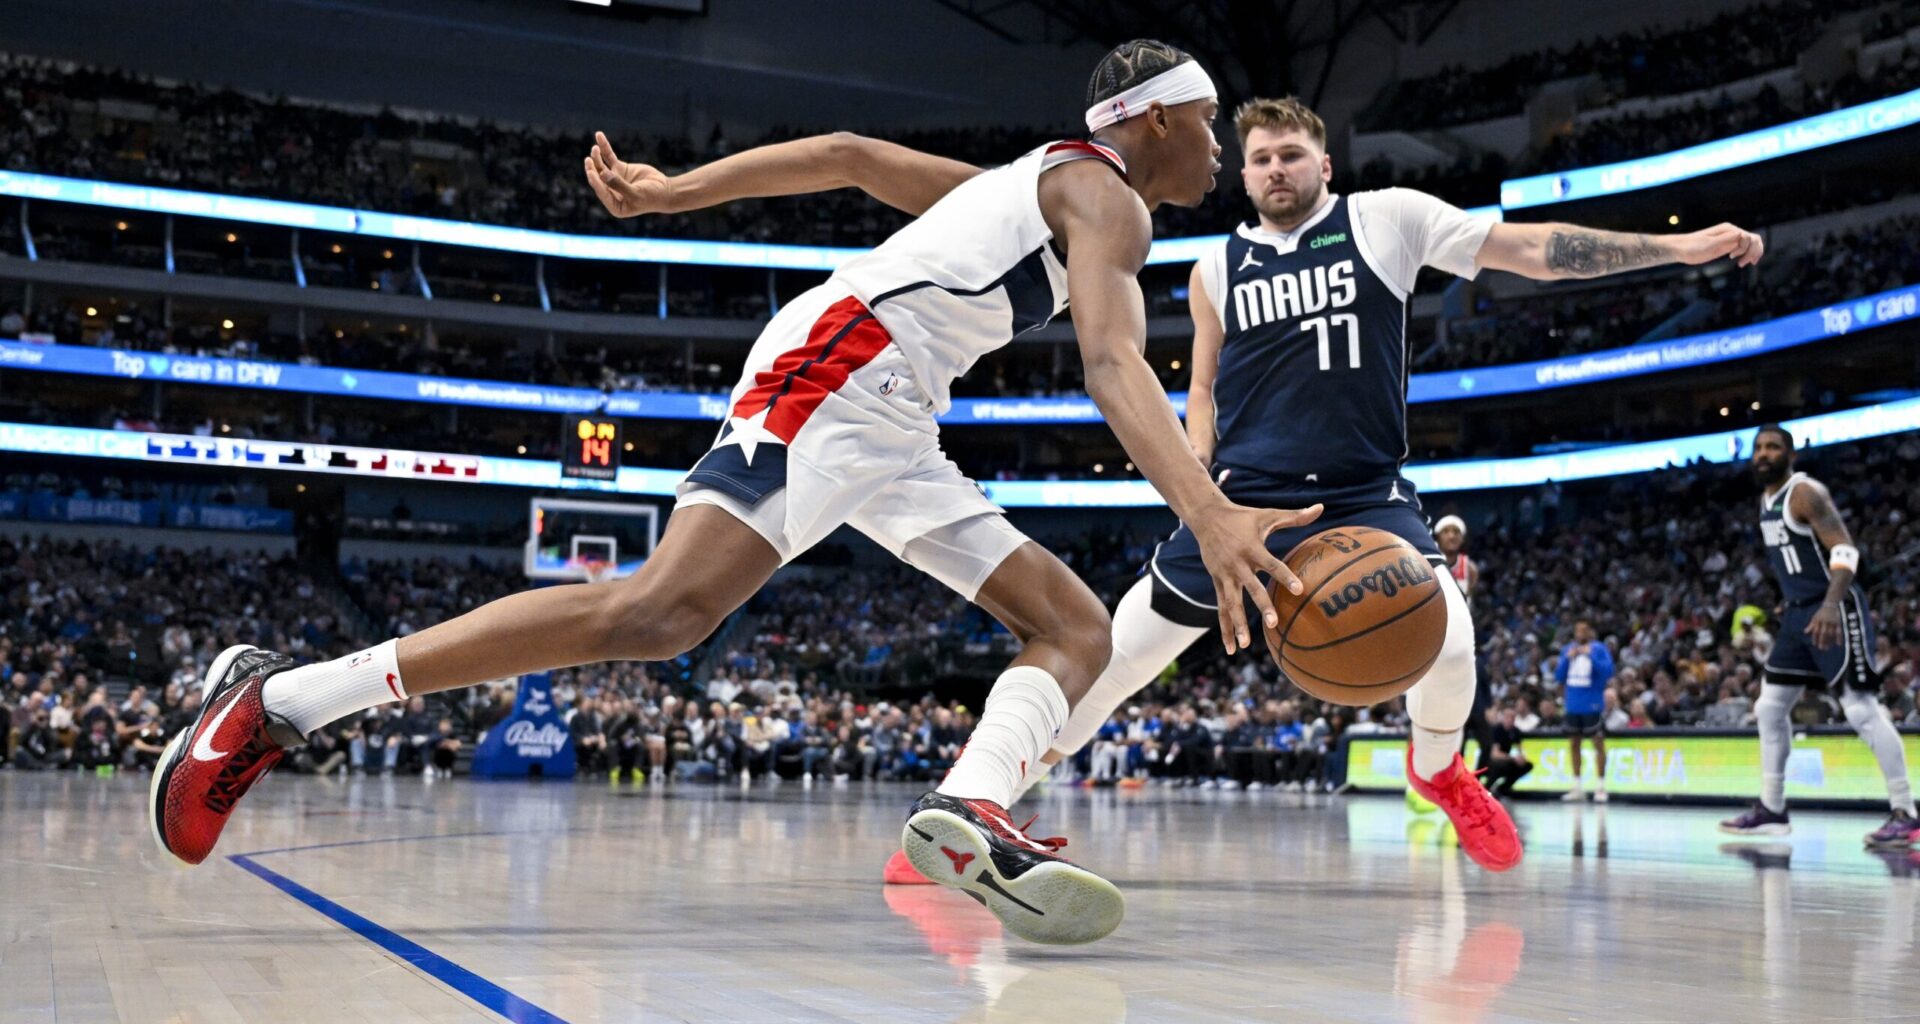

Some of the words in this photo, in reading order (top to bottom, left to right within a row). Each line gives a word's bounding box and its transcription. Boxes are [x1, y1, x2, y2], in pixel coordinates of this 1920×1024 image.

[1310, 232, 1347, 249] chime
[1233, 260, 1357, 332] MAVS
[1820, 307, 1852, 335] Top
[1877, 293, 1916, 321] care
[1300, 313, 1361, 371] 77
[1662, 342, 1717, 363] Medical
[1719, 333, 1765, 354] Center
[112, 351, 145, 378] Top
[171, 360, 212, 381] care
[216, 360, 233, 382] in
[237, 362, 281, 385] DFW
[699, 395, 727, 420] Top
[583, 438, 609, 466] 14
[1779, 544, 1802, 575] 11
[1319, 556, 1432, 618] Wilson
[504, 720, 568, 752] Bally
